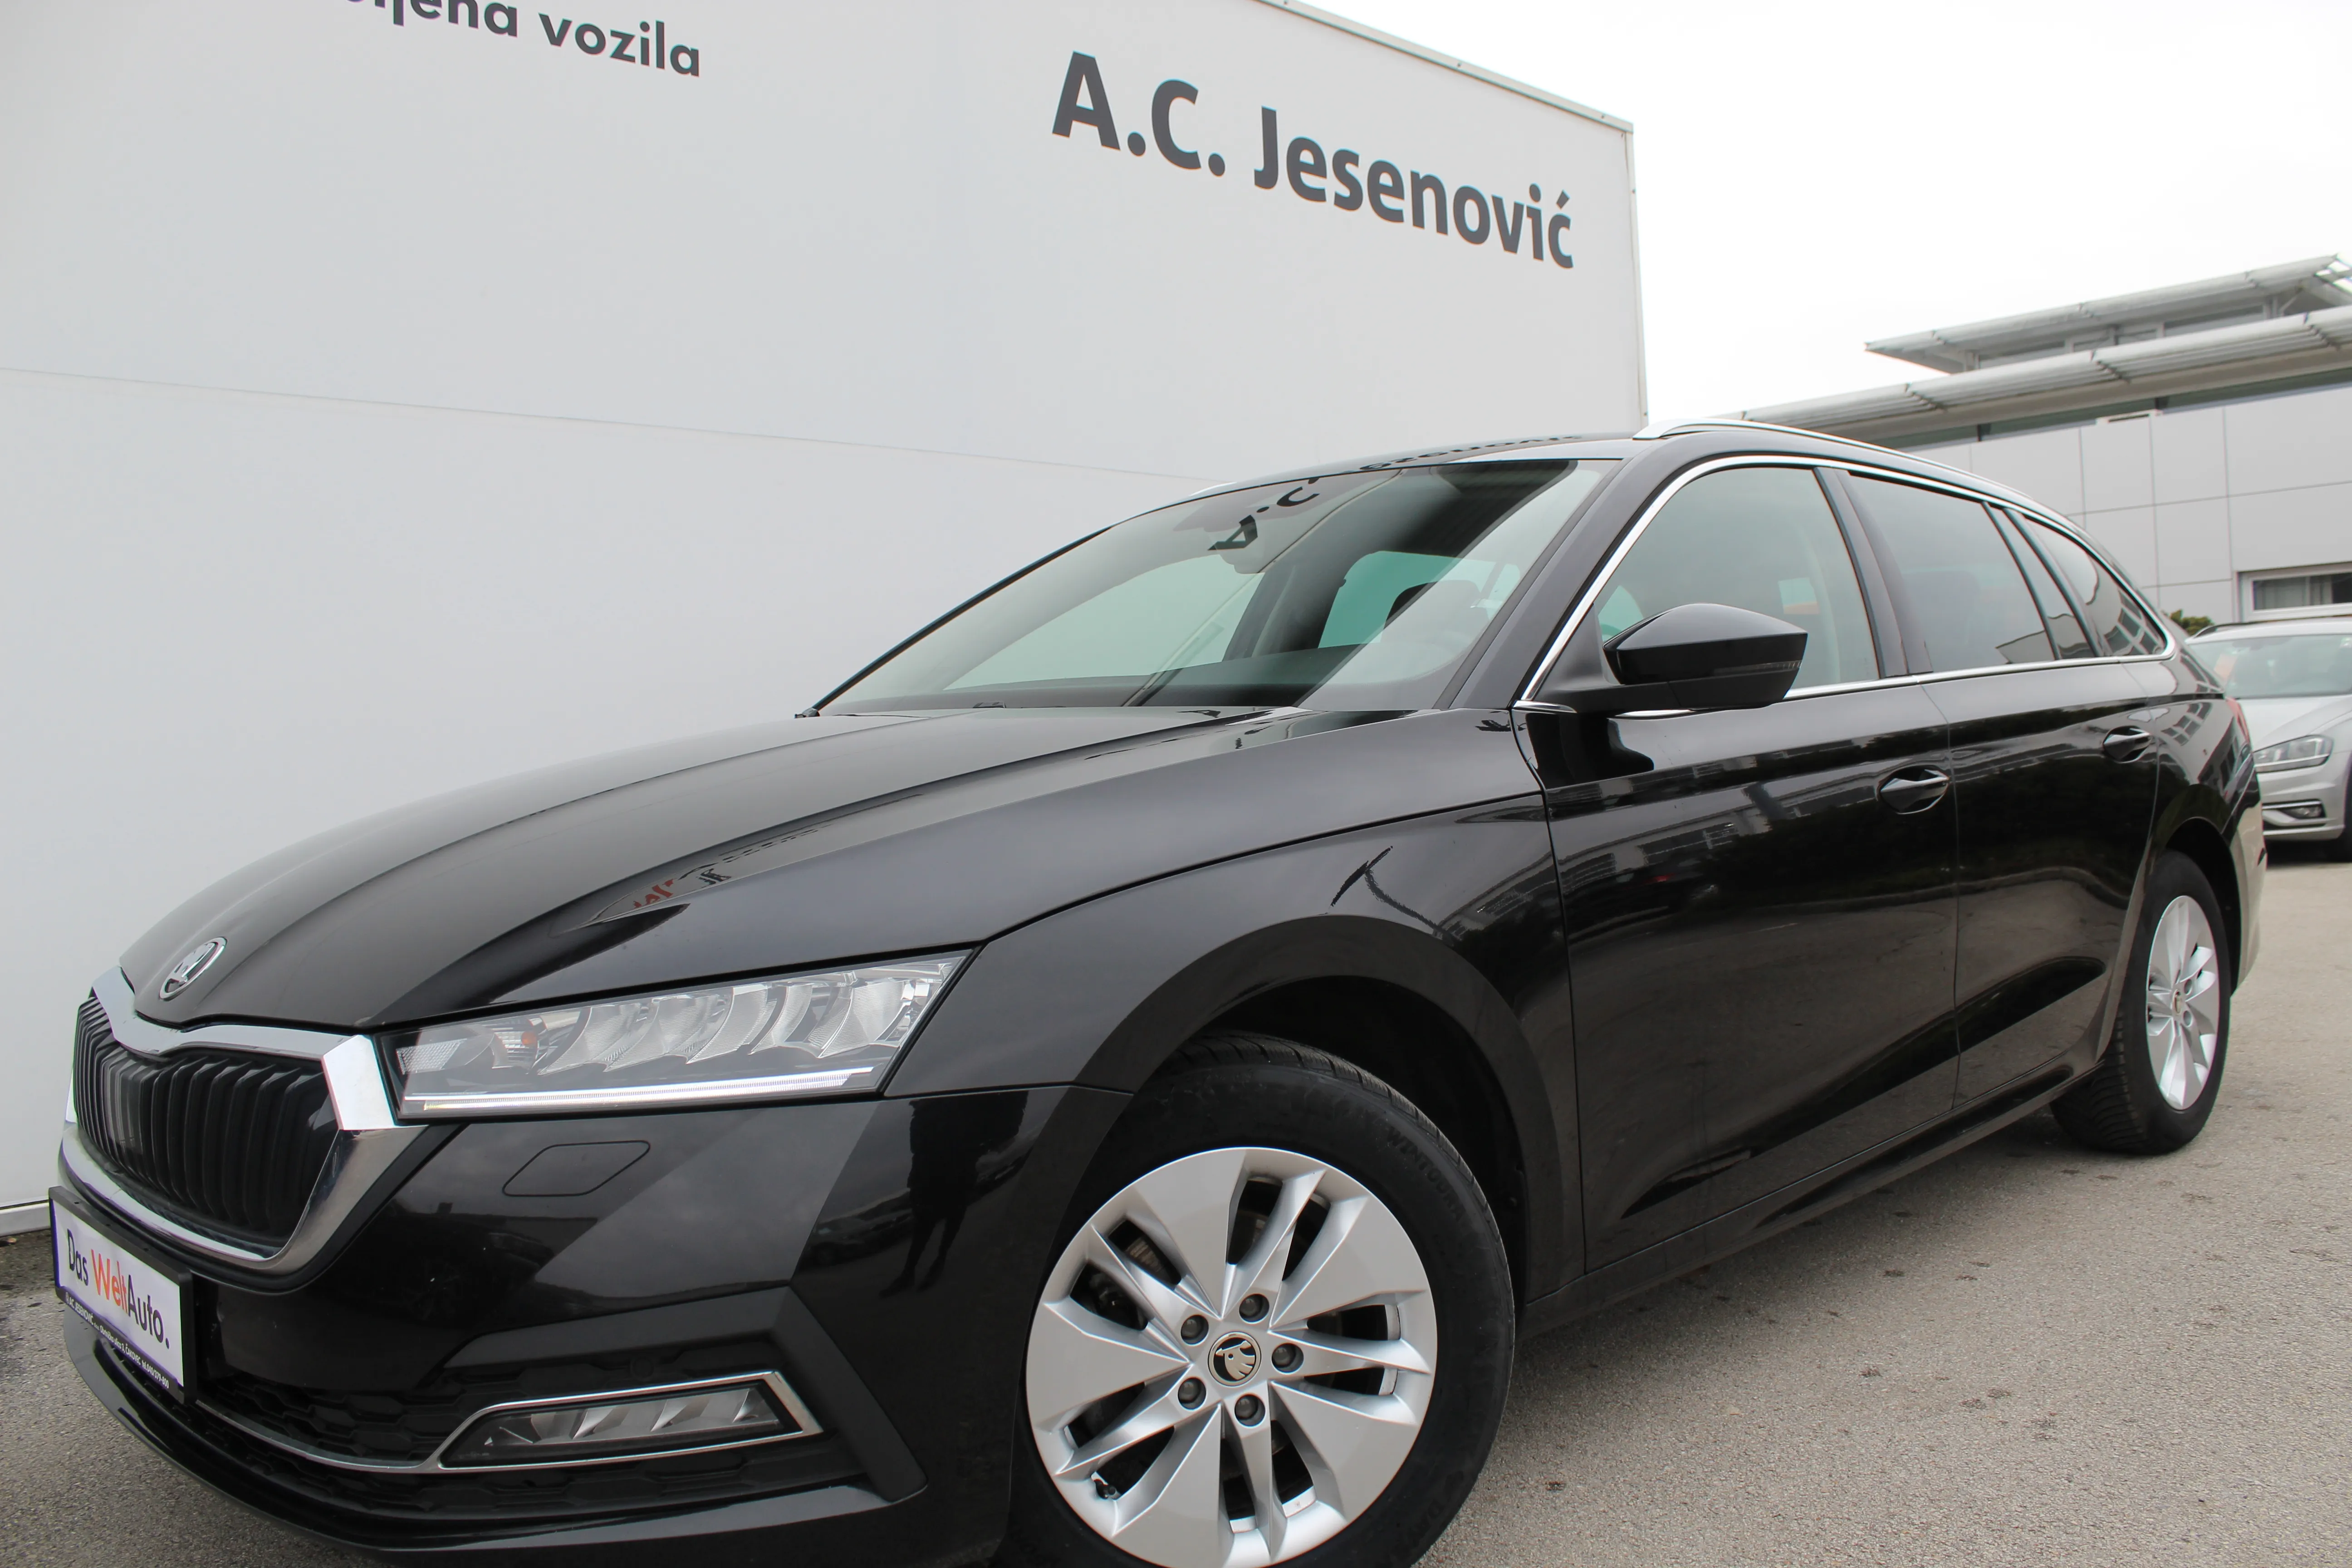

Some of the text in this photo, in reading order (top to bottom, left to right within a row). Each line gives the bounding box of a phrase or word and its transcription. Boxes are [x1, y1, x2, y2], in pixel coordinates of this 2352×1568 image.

[538, 13, 699, 77] vozila
[1051, 50, 1574, 269] A.C. Jesenović
[67, 1229, 170, 1349] Das WeltAuto.
[126, 1343, 141, 1365] ČAKOVEC
